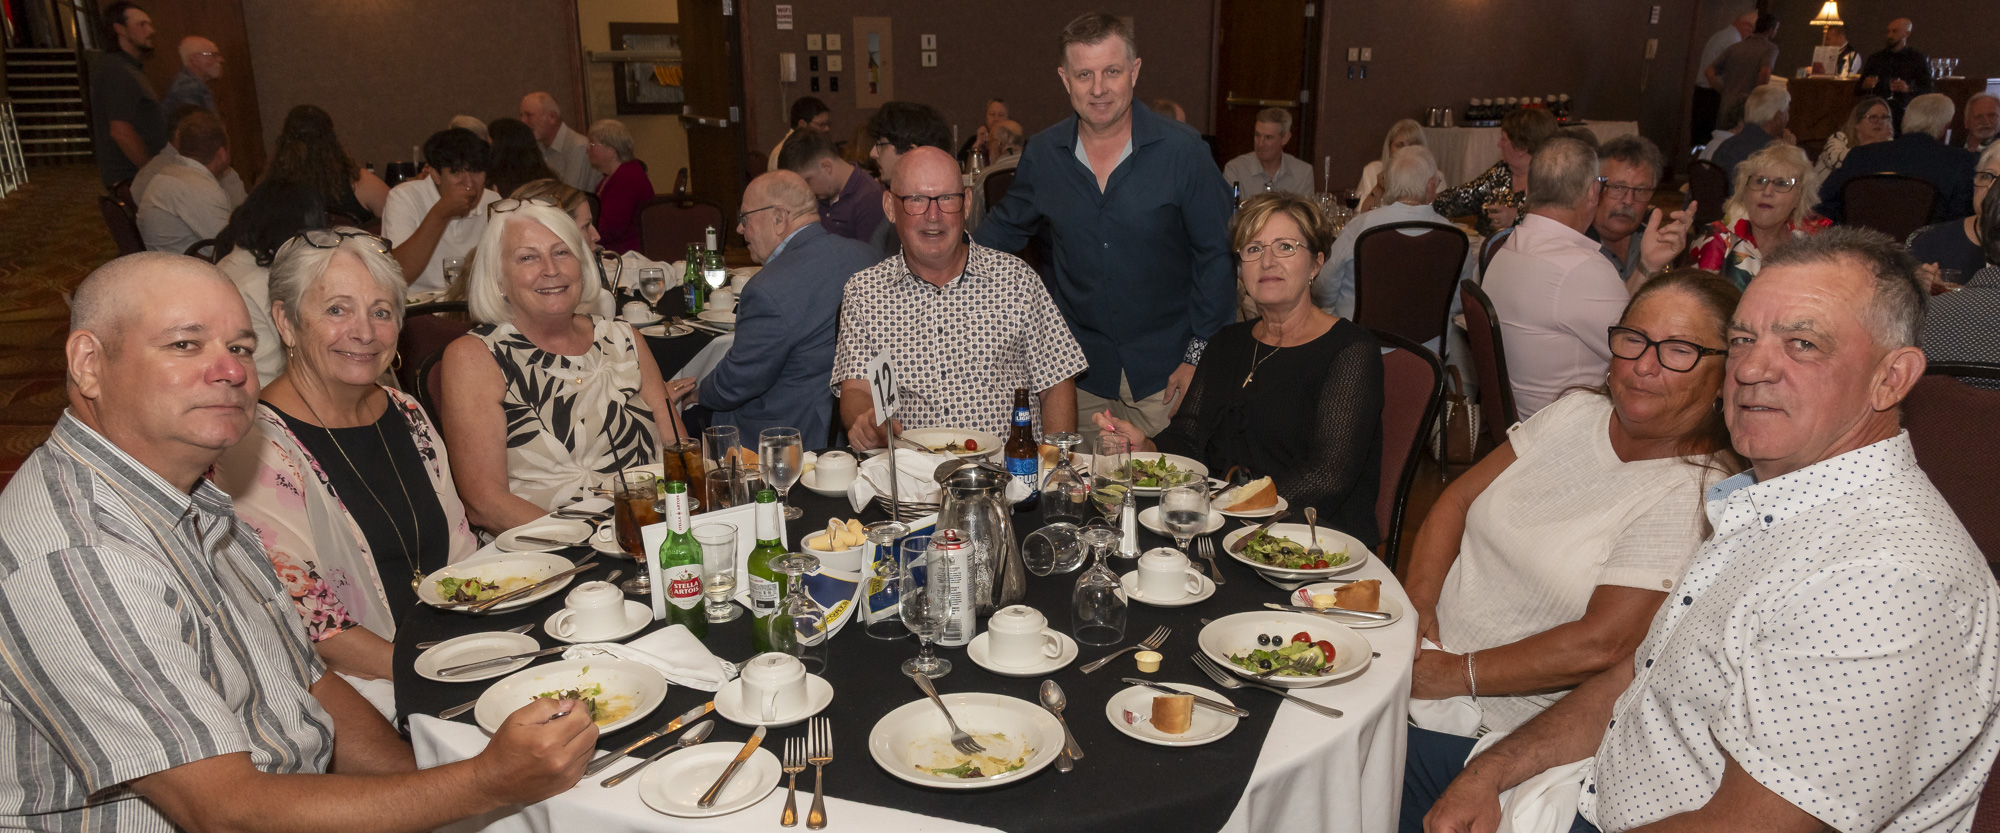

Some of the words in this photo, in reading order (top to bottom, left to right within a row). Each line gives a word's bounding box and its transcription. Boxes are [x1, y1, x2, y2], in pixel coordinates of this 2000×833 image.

[874, 362, 895, 410] 12
[673, 580, 699, 589] STELLA
[673, 586, 700, 595] ARTOIS
